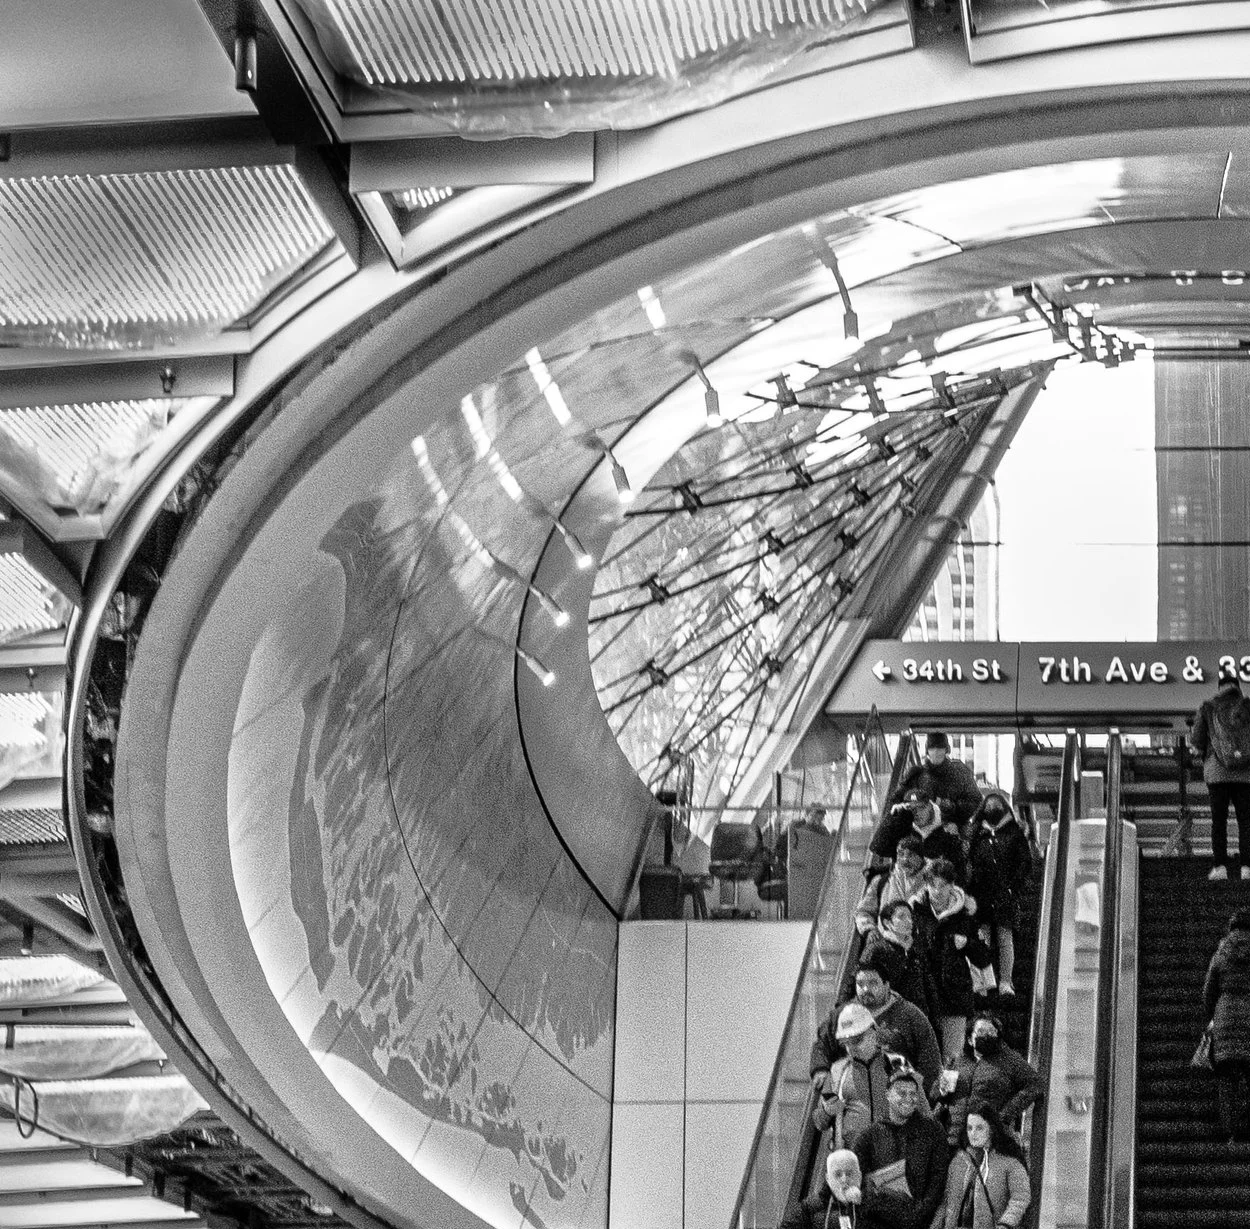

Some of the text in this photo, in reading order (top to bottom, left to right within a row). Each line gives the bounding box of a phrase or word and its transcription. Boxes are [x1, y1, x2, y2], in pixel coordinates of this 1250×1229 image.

[903, 658, 1000, 681] 34th St
[1038, 656, 1092, 683] 7th
[1105, 656, 1169, 683] Ave
[1182, 655, 1204, 682] &
